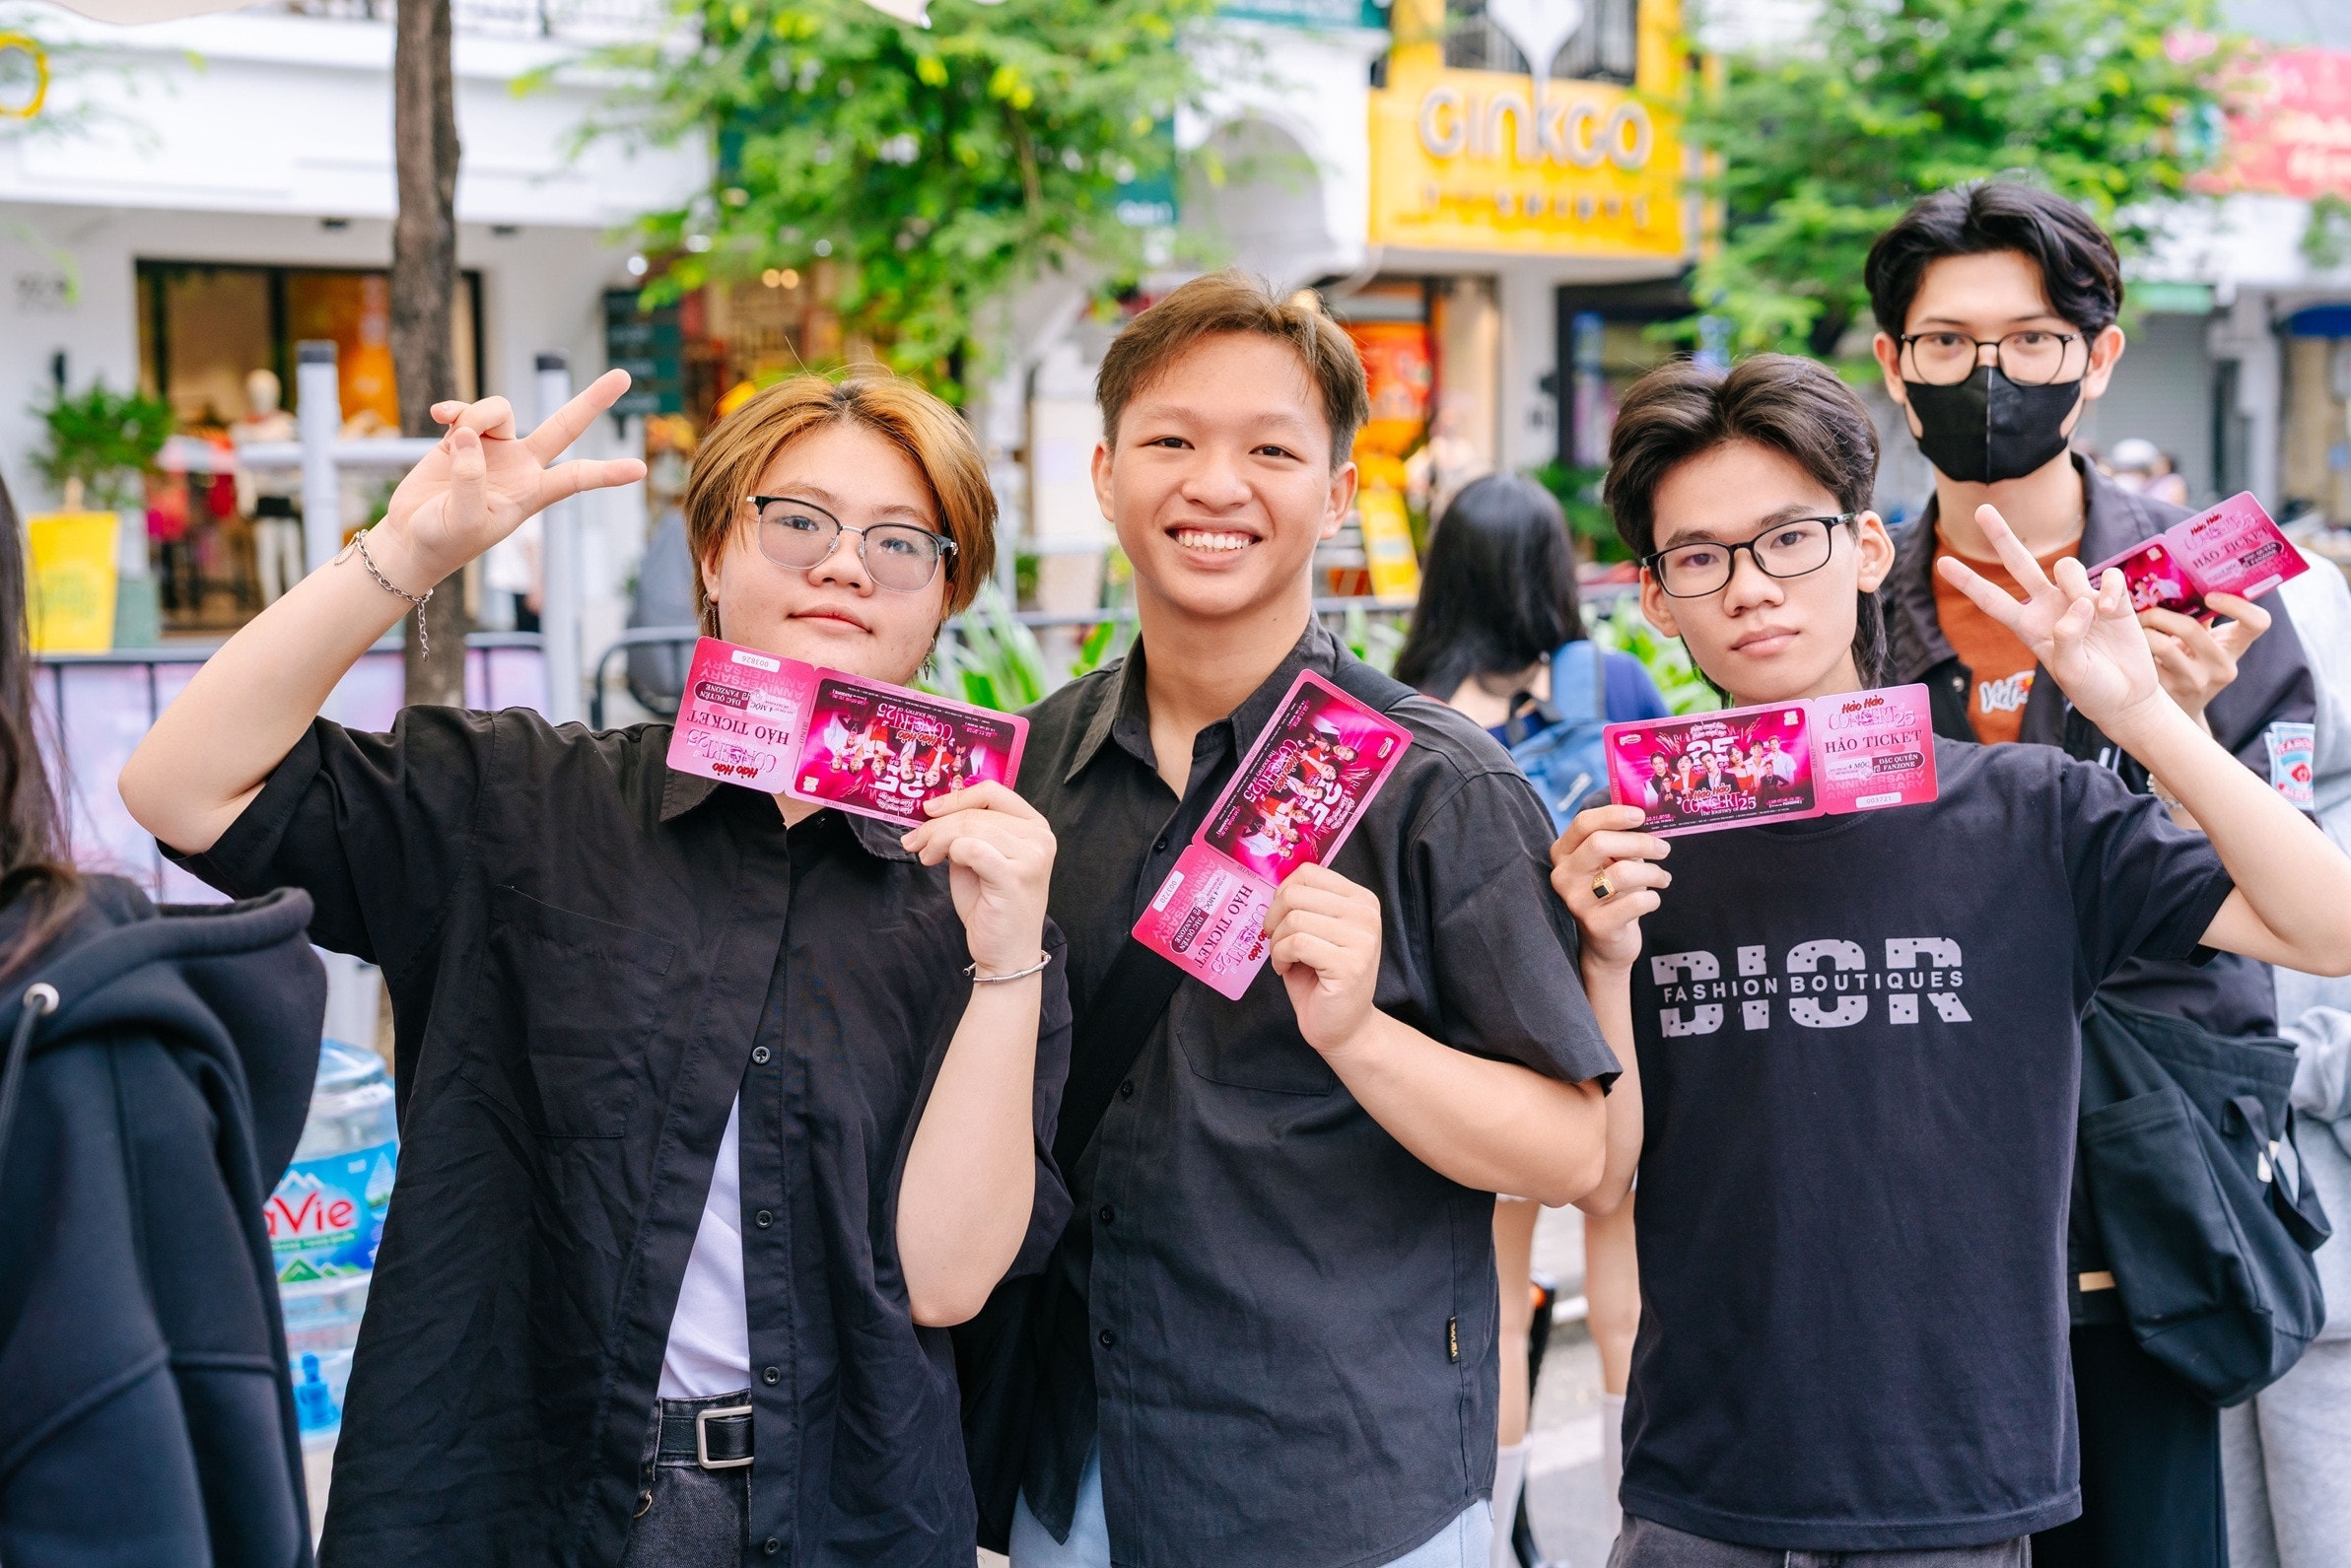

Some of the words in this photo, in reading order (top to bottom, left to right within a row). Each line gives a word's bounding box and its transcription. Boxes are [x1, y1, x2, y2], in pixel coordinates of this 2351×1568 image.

[705, 683, 739, 697] FANZONE
[686, 708, 749, 735] TICKET
[876, 702, 896, 719] 25
[753, 724, 789, 748] HẢO
[1824, 735, 1857, 753] HẢO
[1862, 729, 1922, 748] TICKET
[1883, 761, 1915, 770] FANZONE
[1241, 782, 1263, 803] 25
[1738, 795, 1757, 810] 25
[1158, 879, 1177, 903] 003720
[1225, 884, 1255, 918] HẢO
[1173, 915, 1195, 943] FANZONE
[1191, 915, 1232, 969] TICKET
[1650, 937, 1972, 1038] DIOR
[1664, 978, 1778, 1003] FASHION
[1790, 971, 1964, 993] BOUTIQUES
[262, 1189, 353, 1236] aVie
